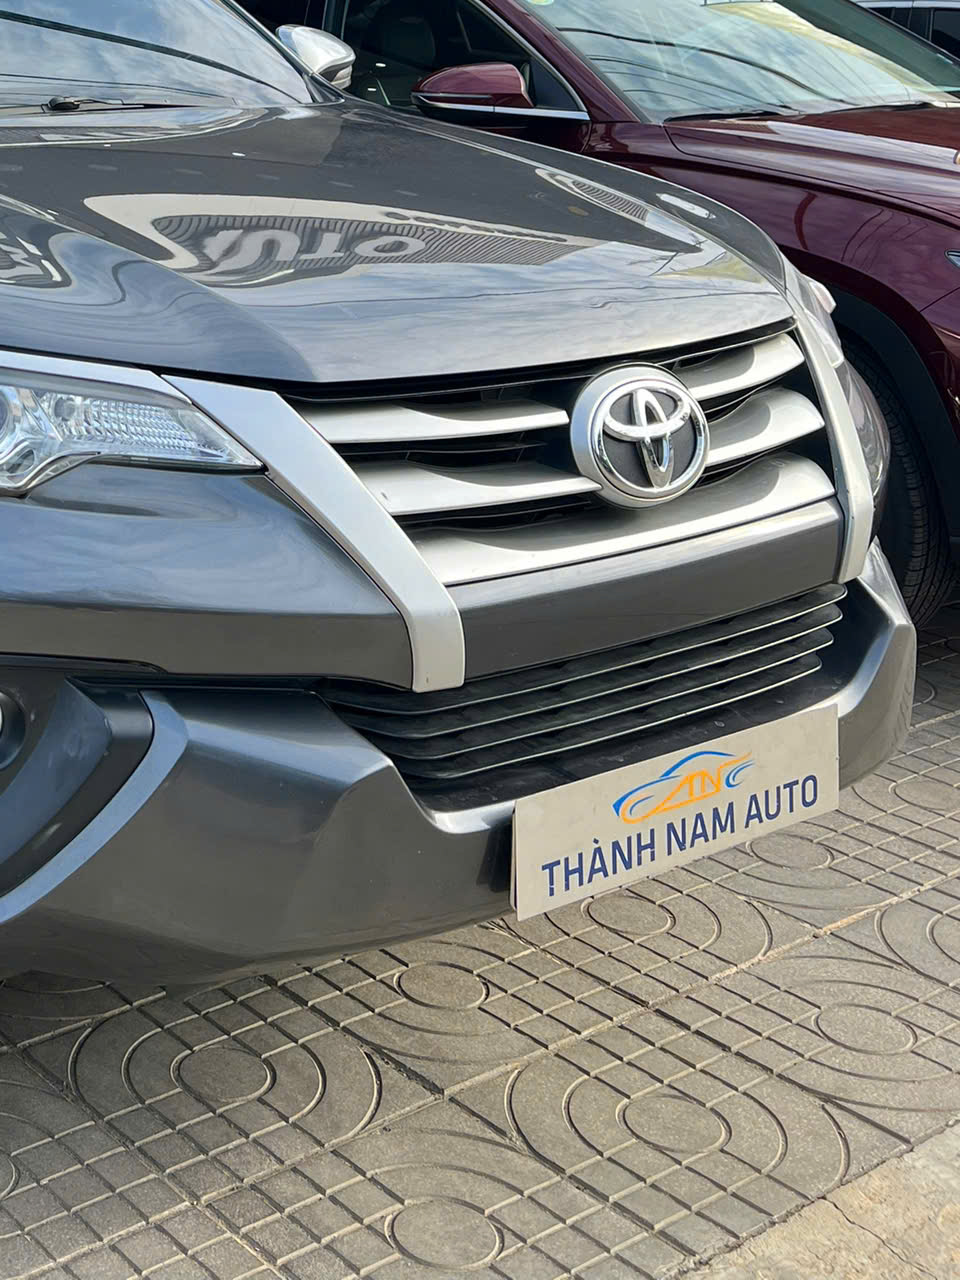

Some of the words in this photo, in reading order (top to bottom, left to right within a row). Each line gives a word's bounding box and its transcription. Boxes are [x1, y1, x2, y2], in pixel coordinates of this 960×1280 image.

[541, 828, 656, 897] THÀNH
[665, 802, 736, 856] NAM
[743, 774, 819, 829] AUTO
